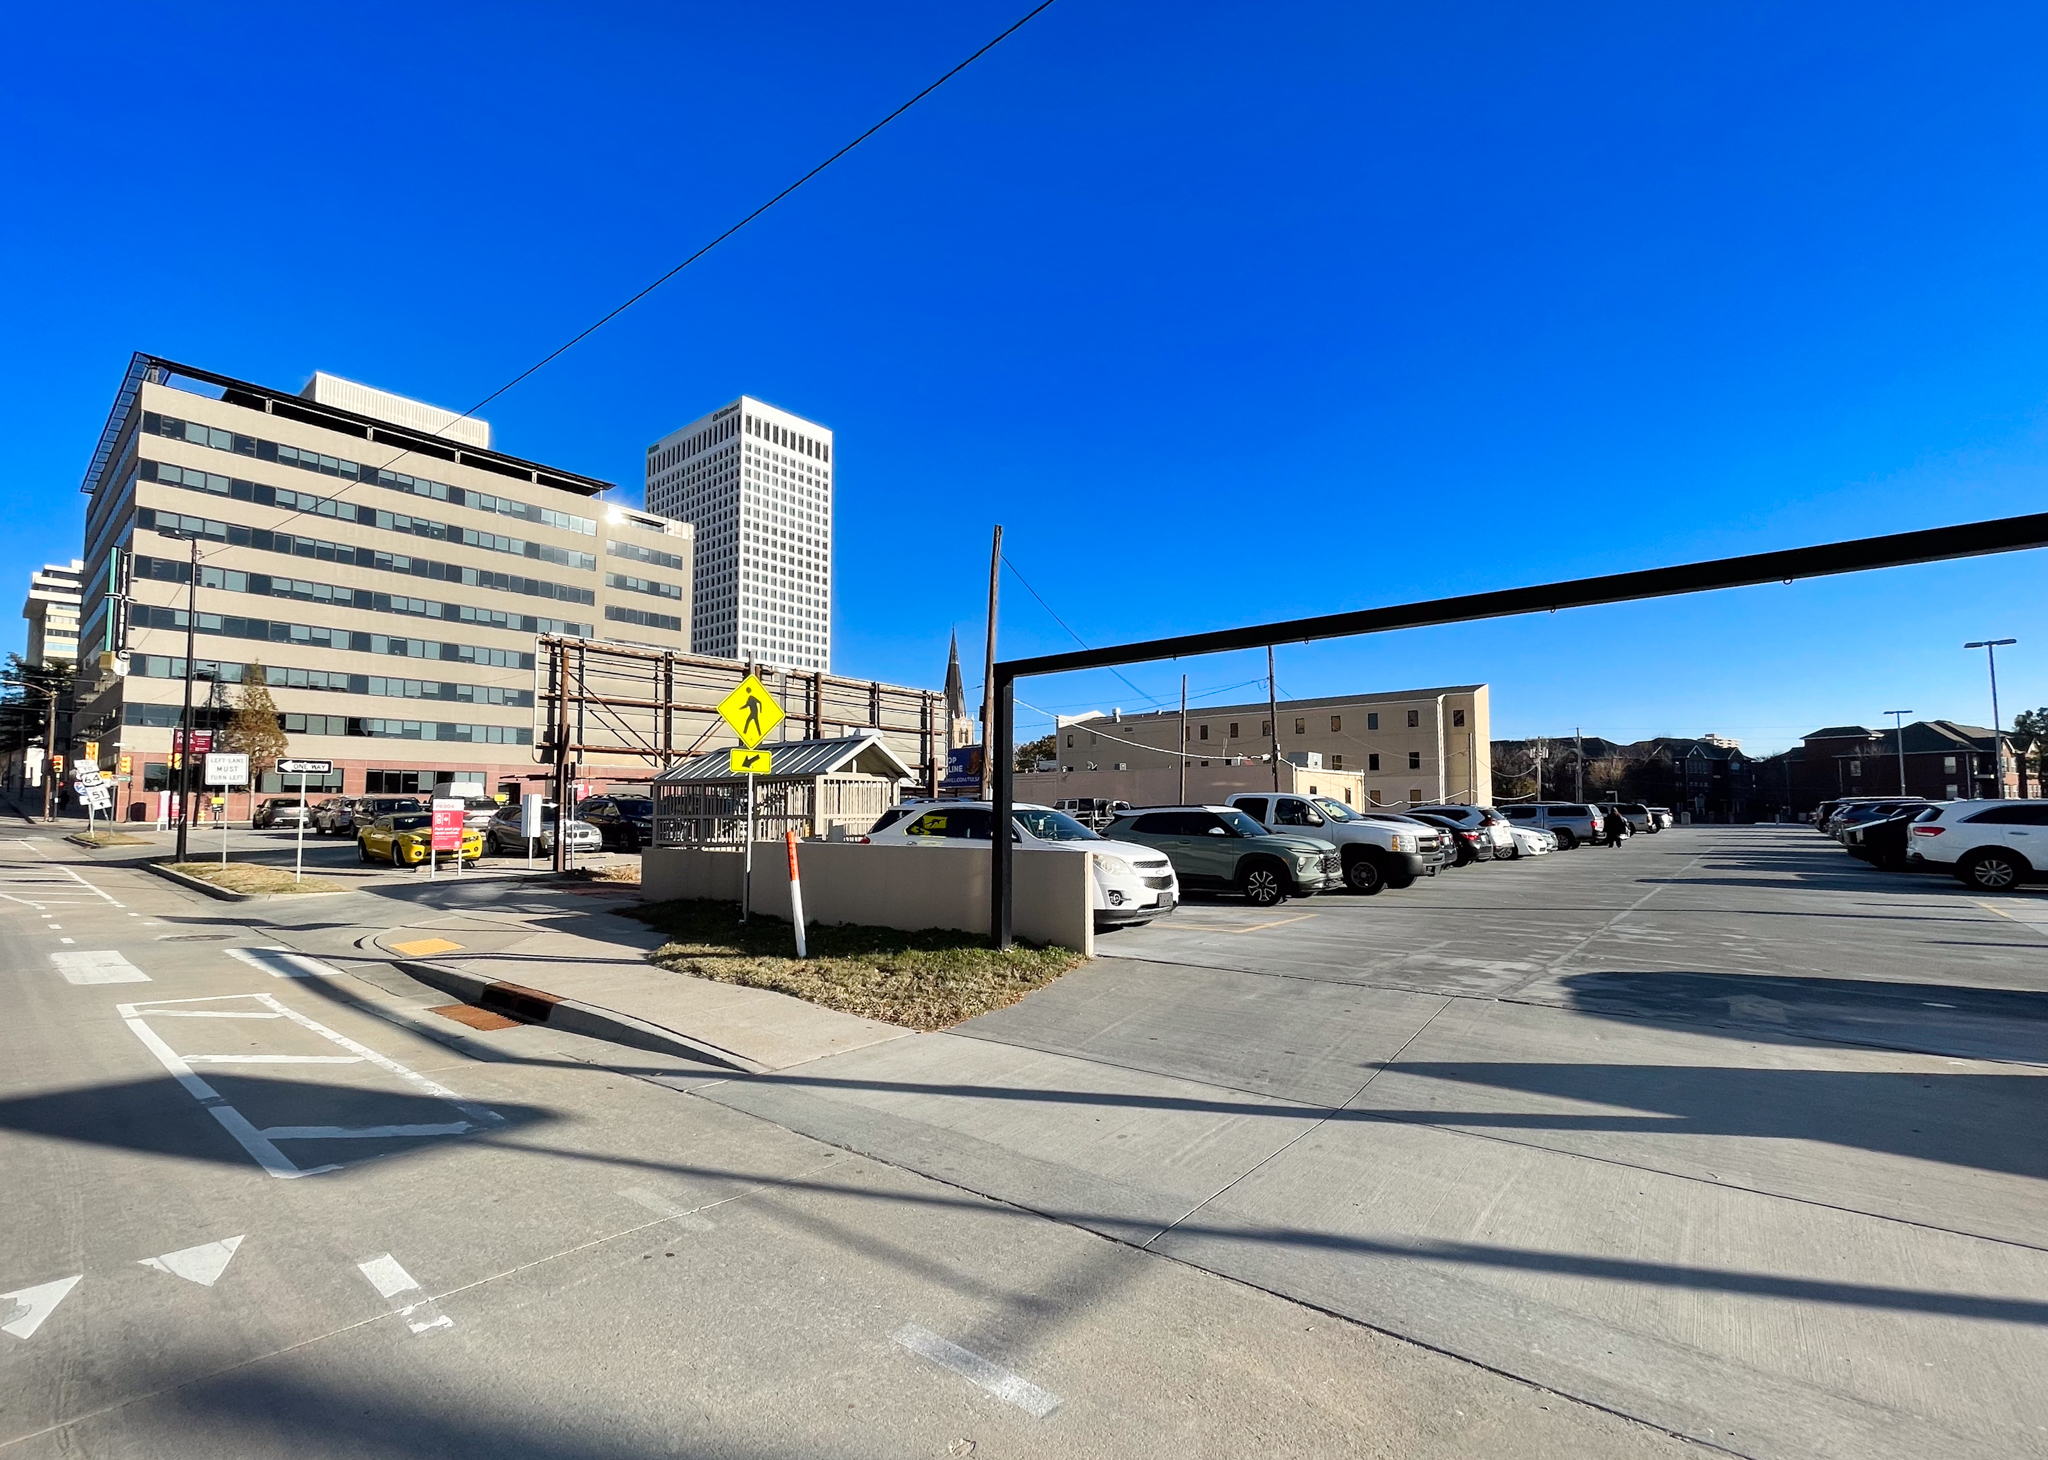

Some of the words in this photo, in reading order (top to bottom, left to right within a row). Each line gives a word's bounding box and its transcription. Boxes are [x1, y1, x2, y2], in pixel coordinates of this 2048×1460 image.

[948, 756, 957, 764] OP
[216, 765, 239, 773] MUST
[948, 764, 963, 773] LINE
[84, 773, 100, 784] 64
[91, 790, 105, 800] 51
